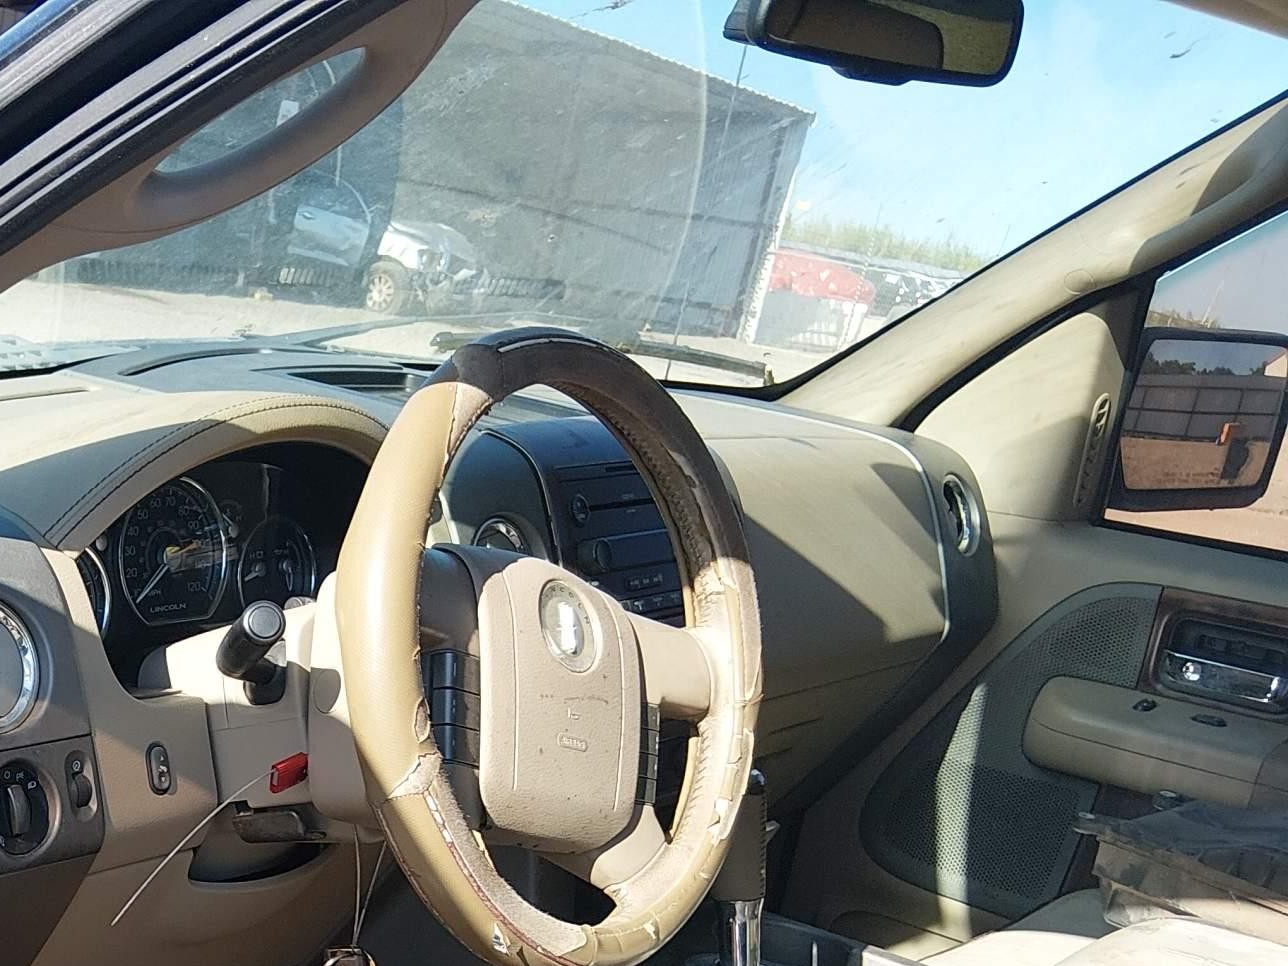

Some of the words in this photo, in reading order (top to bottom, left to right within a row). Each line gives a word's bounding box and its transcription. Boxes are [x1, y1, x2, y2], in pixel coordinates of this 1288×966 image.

[126, 568, 138, 578] 20
[188, 582, 201, 592] 120
[150, 603, 187, 613] LINCOLN
